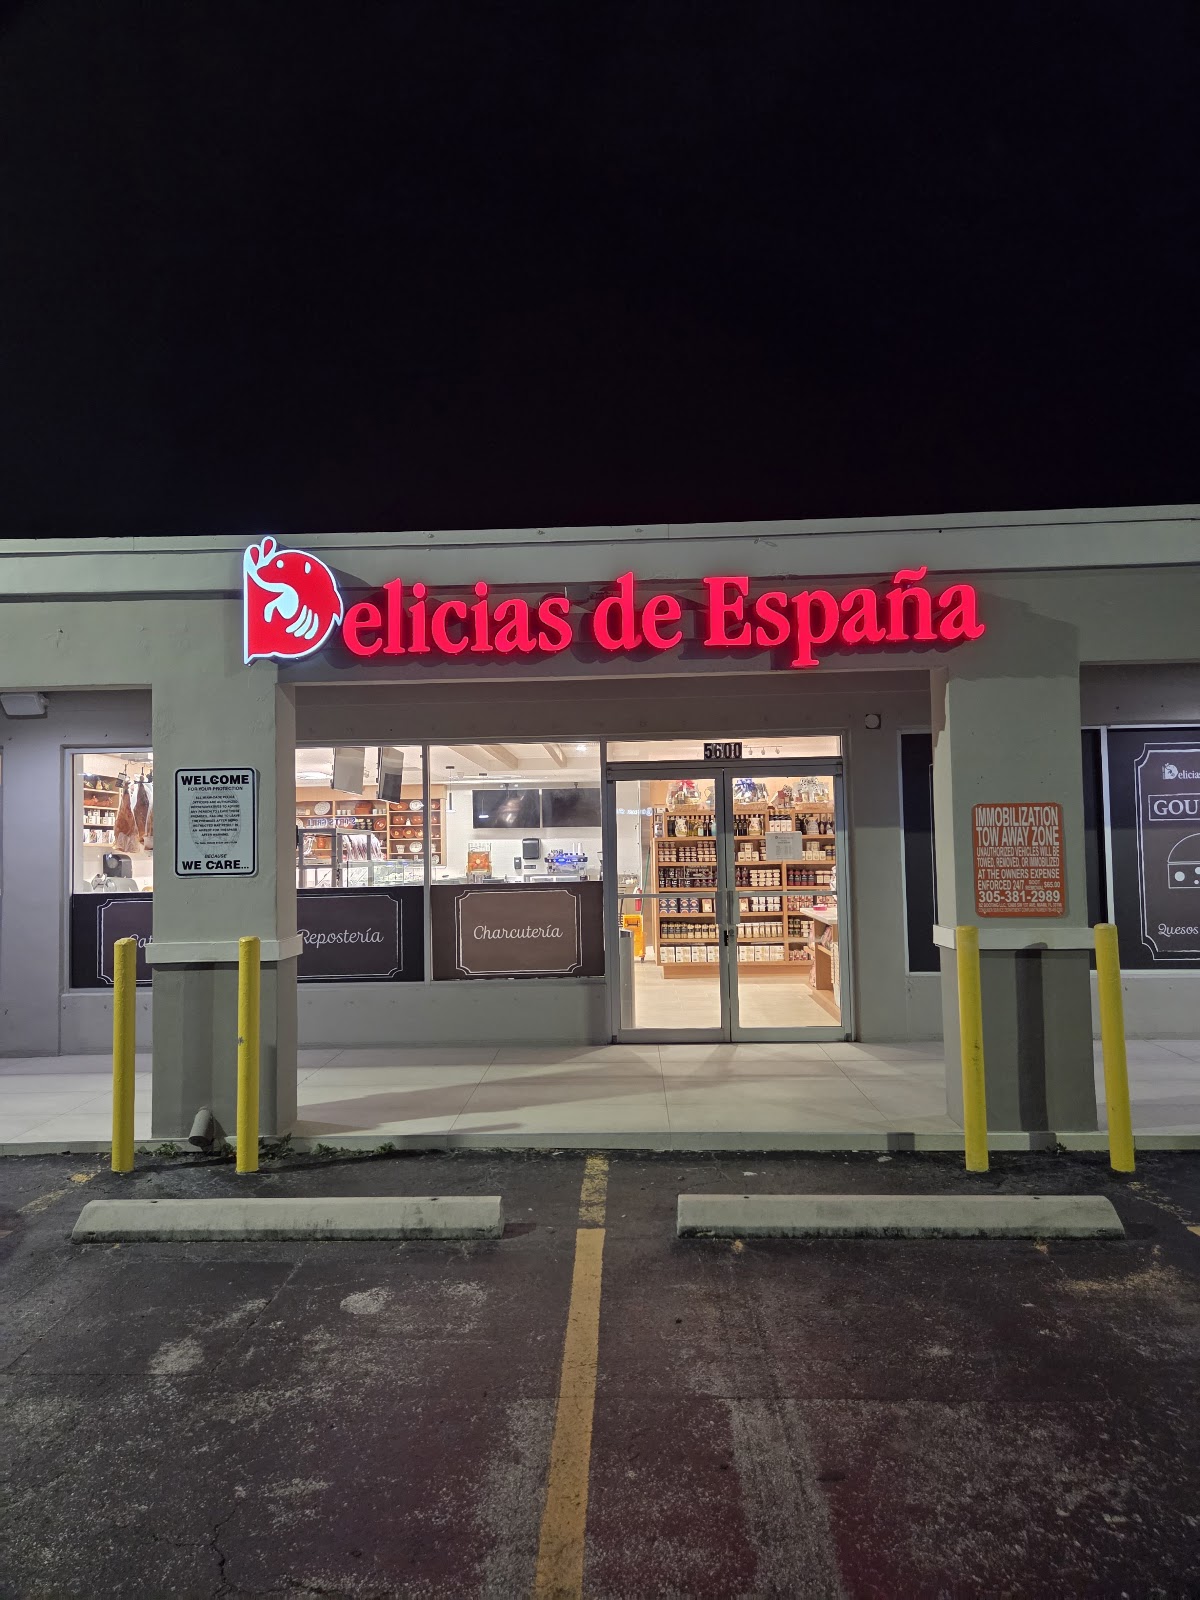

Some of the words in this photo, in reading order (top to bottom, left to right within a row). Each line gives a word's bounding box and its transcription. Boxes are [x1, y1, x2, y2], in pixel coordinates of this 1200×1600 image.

[243, 536, 573, 665] Delicias
[593, 571, 683, 650] de
[703, 566, 985, 668] España
[704, 742, 742, 759] 5600
[181, 775, 250, 785] WELCOME
[975, 806, 1059, 827] IMMOBILIZATION
[976, 826, 1000, 847] TOW
[1001, 826, 1030, 847] AWAY
[1031, 825, 1060, 846] ZONE
[976, 846, 1014, 857] UNAUTHORIZED
[1015, 846, 1039, 857] VEHICLES
[1039, 846, 1052, 857] WILL
[1053, 846, 1060, 856] BE
[182, 861, 202, 870] WE
[206, 860, 249, 869] CARE...
[1021, 857, 1029, 868] OR
[1029, 857, 1060, 867] IMMOBILIZED
[977, 869, 985, 879] AT
[986, 869, 1000, 879] THE
[1001, 869, 1029, 879] OWNERS
[1030, 868, 1060, 879] EXPENSE
[978, 880, 1012, 890] ENFORCED
[978, 890, 1060, 902] 305-381-2989
[473, 924, 563, 940] Charcutería
[1158, 923, 1199, 938] Quesos
[297, 928, 384, 948] Repostería
